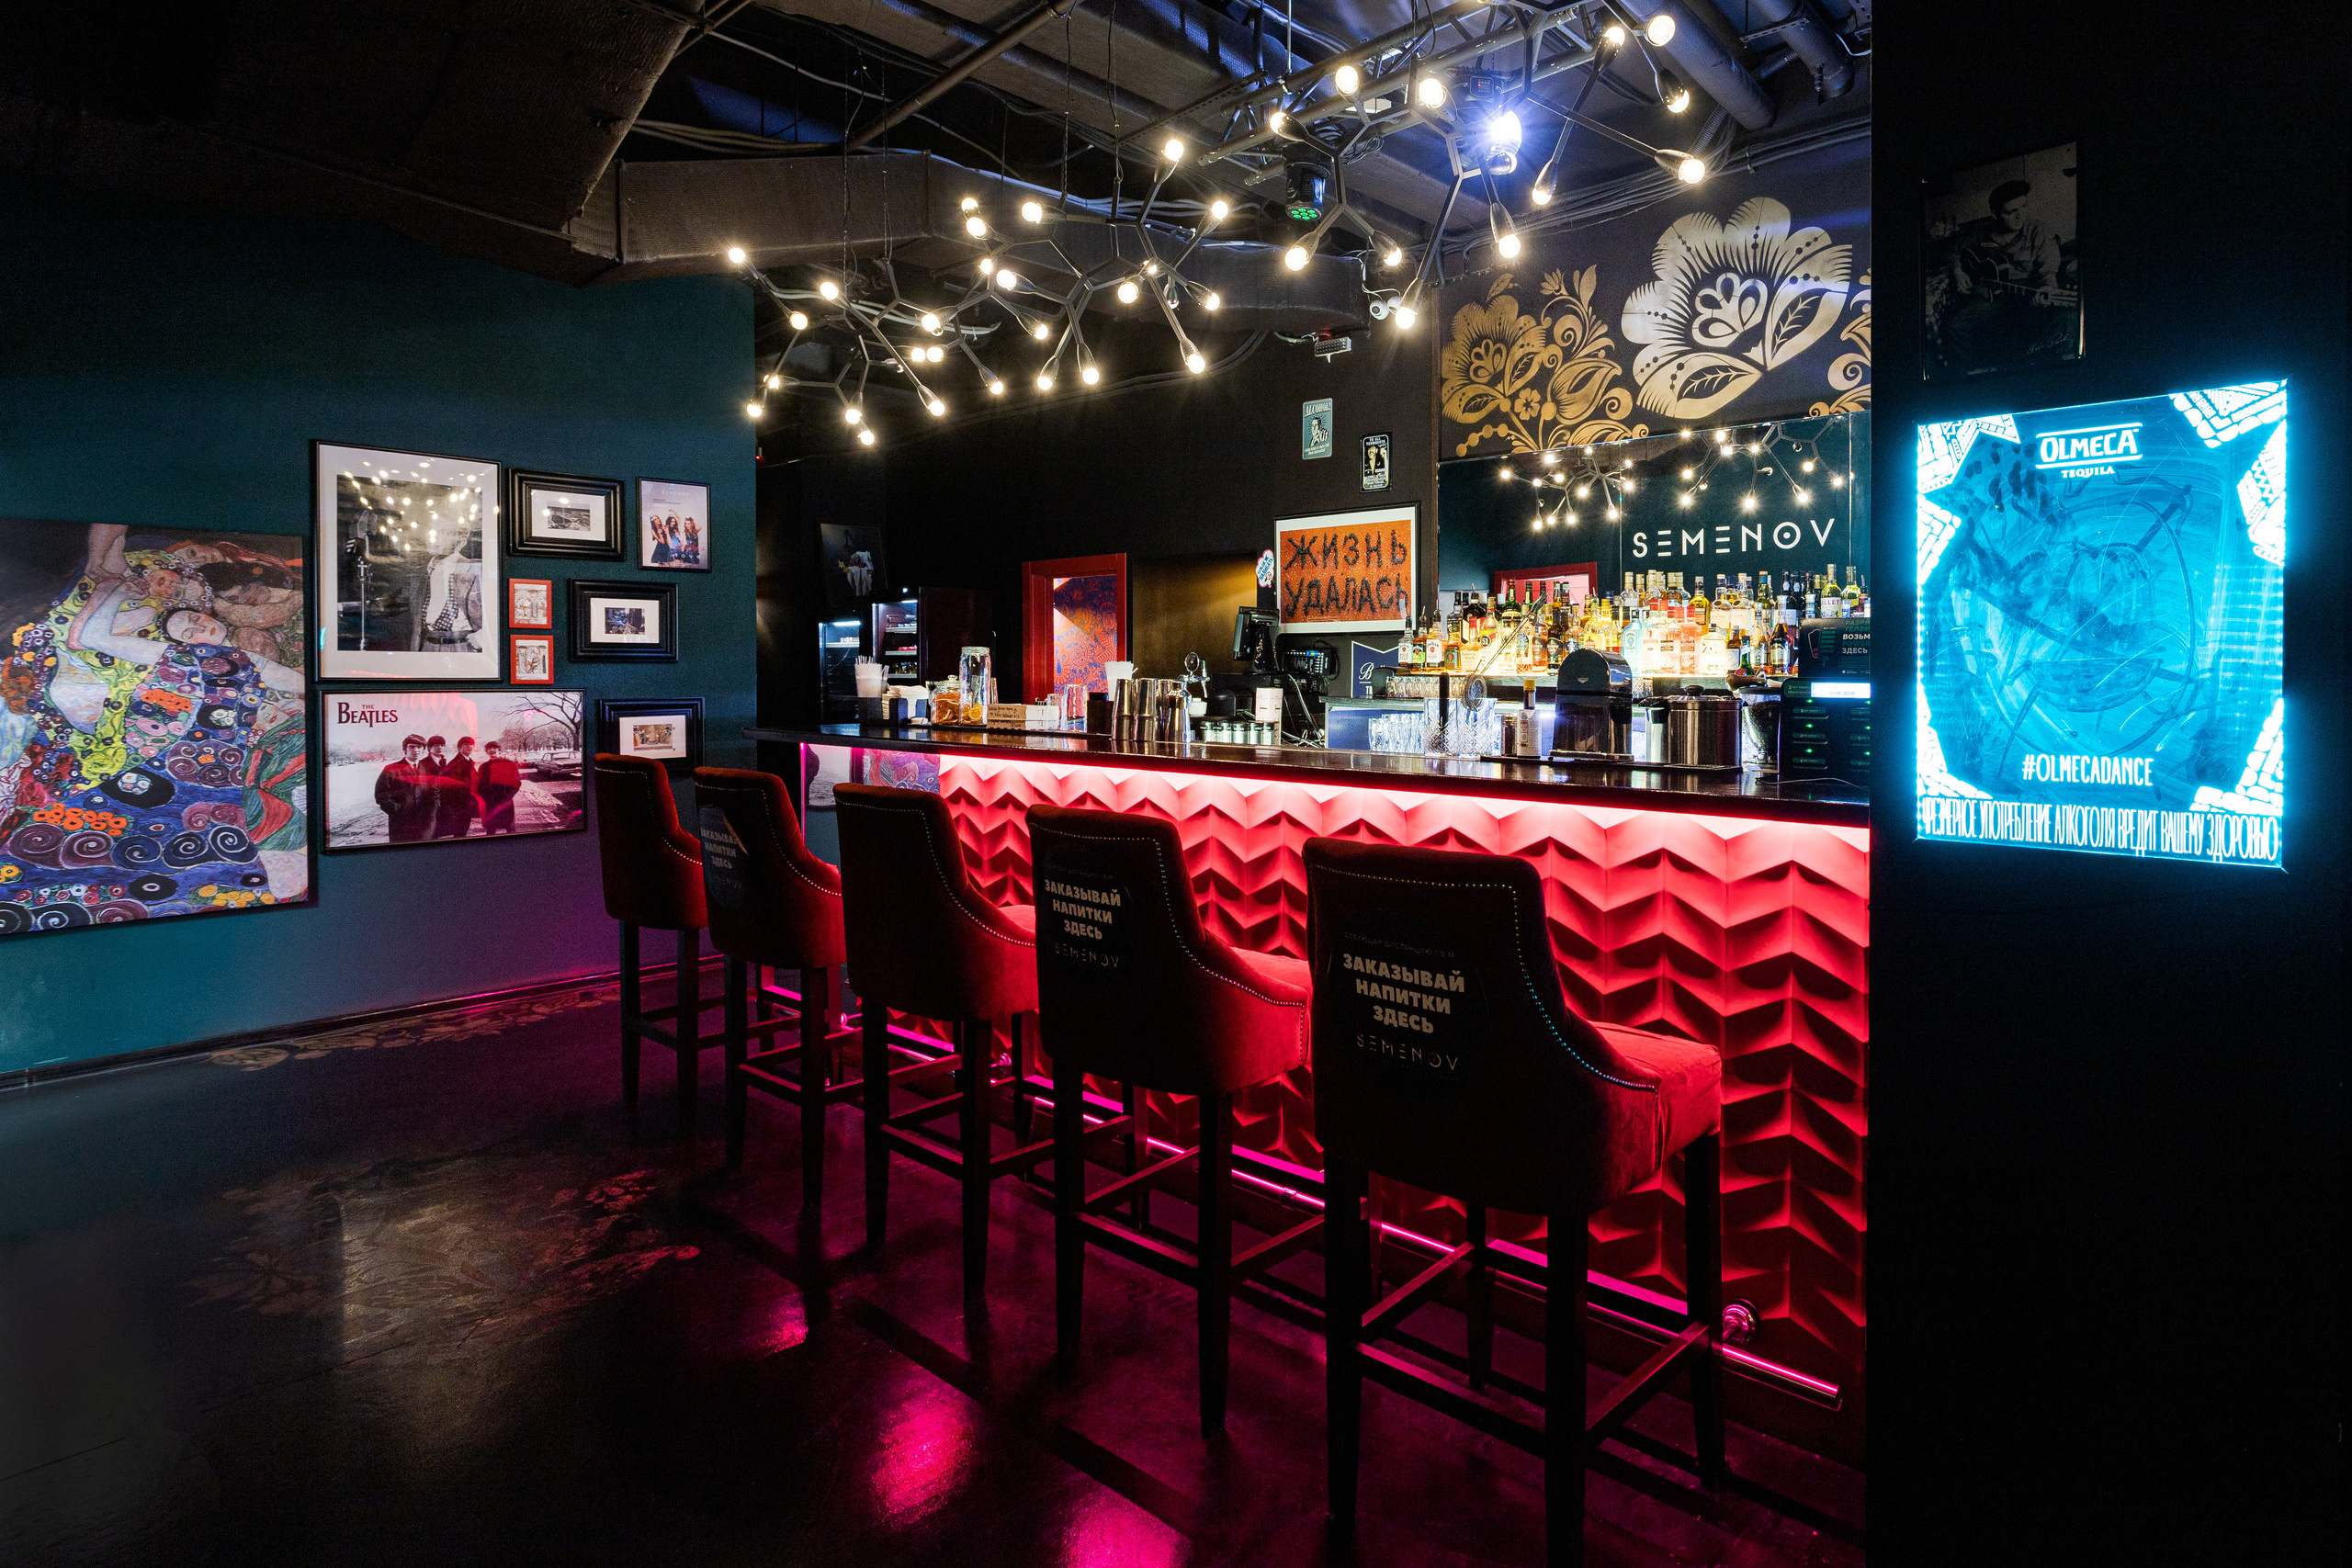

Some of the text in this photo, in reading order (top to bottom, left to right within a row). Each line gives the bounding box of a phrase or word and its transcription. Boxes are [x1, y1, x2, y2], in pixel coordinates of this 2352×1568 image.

[1305, 401, 1331, 417] ALCOHOL!
[2041, 429, 2138, 462] OLMECA
[2061, 466, 2115, 478] TEQUILA
[1283, 529, 1408, 570] ЖИЗНЬ
[1633, 518, 1835, 558] SEMENOV
[1285, 573, 1408, 617] УДАЛАСЬ
[1842, 647, 1868, 655] ЗДЕСЬ
[2022, 753, 2154, 785] #OLMECADANCE
[1923, 797, 2278, 863] ЧРЕЗМЕРНОЕ УПОТРЕБЛЕНИЕ АЛКОГОЛЯ ВРЕДИТ ВАШЕМУ ЗДОРОВЬЮ
[711, 855, 733, 869] ЗДЕСЬ
[1045, 879, 1121, 907] ЗАКАЗЫВАЙ
[1052, 898, 1113, 924] НАПИТКИ
[1064, 919, 1102, 940] ЗДЕСЬ
[1055, 942, 1119, 968] SEMENOV
[1342, 953, 1465, 993] ЗАКАЗЫВАЙ
[1355, 978, 1451, 1014] НАПИТКИ
[1373, 1005, 1434, 1033] ЗДЕСЬ
[1356, 1032, 1458, 1070] SEMENOV
